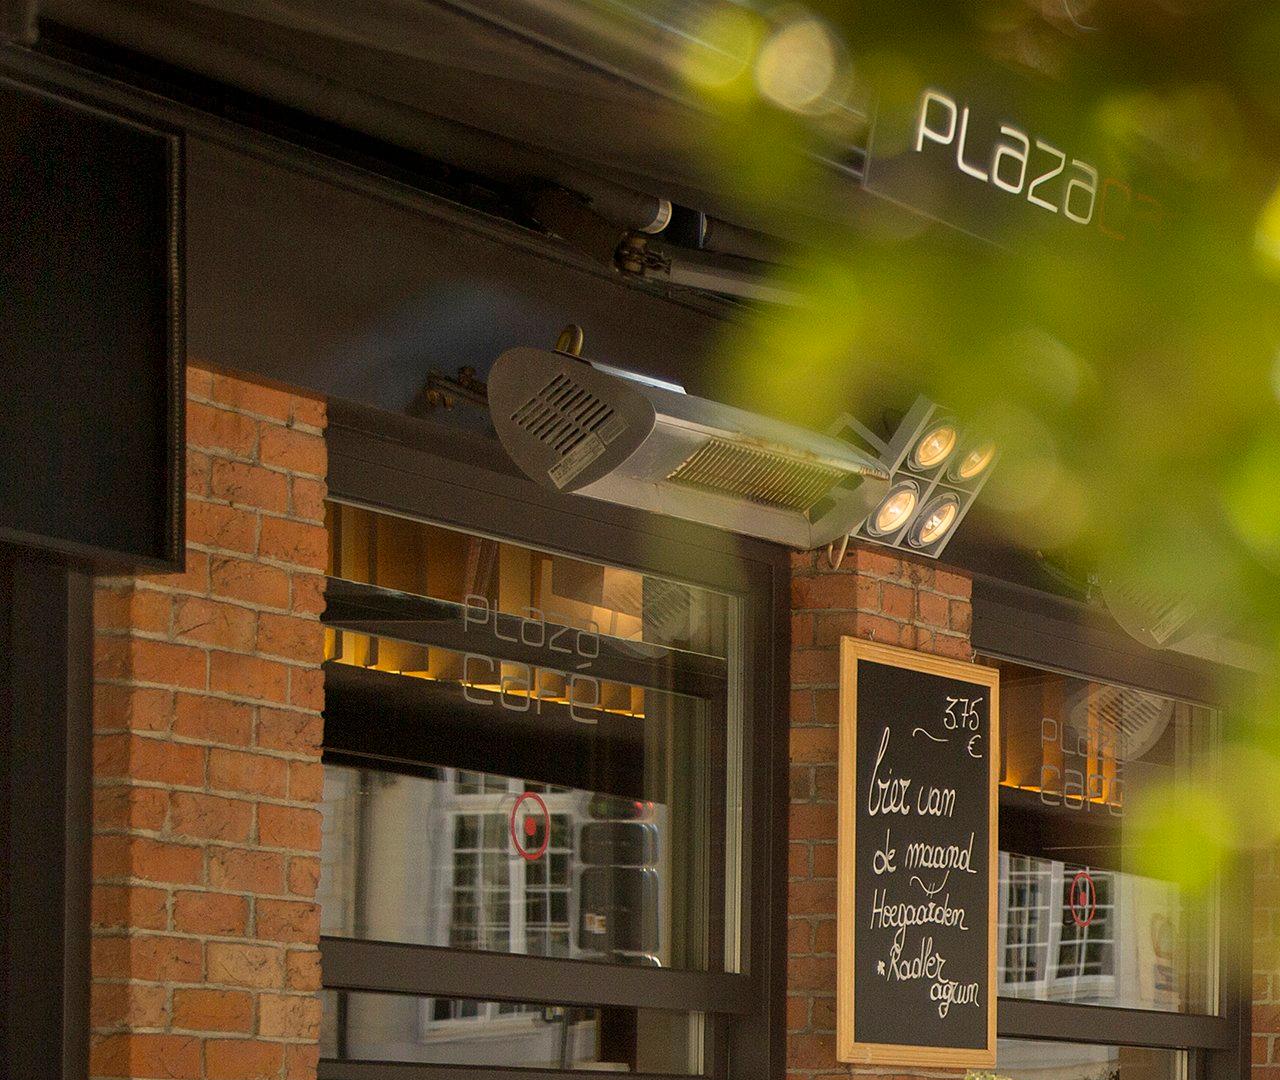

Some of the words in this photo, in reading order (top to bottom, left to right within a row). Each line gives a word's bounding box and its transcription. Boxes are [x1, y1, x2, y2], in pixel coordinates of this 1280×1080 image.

[943, 696, 984, 731] 3.75
[966, 734, 983, 759] €
[868, 726, 912, 817] bier
[917, 785, 956, 818] van
[872, 828, 897, 875] de
[904, 831, 978, 874] maand
[869, 888, 970, 953] Hoegaarden
